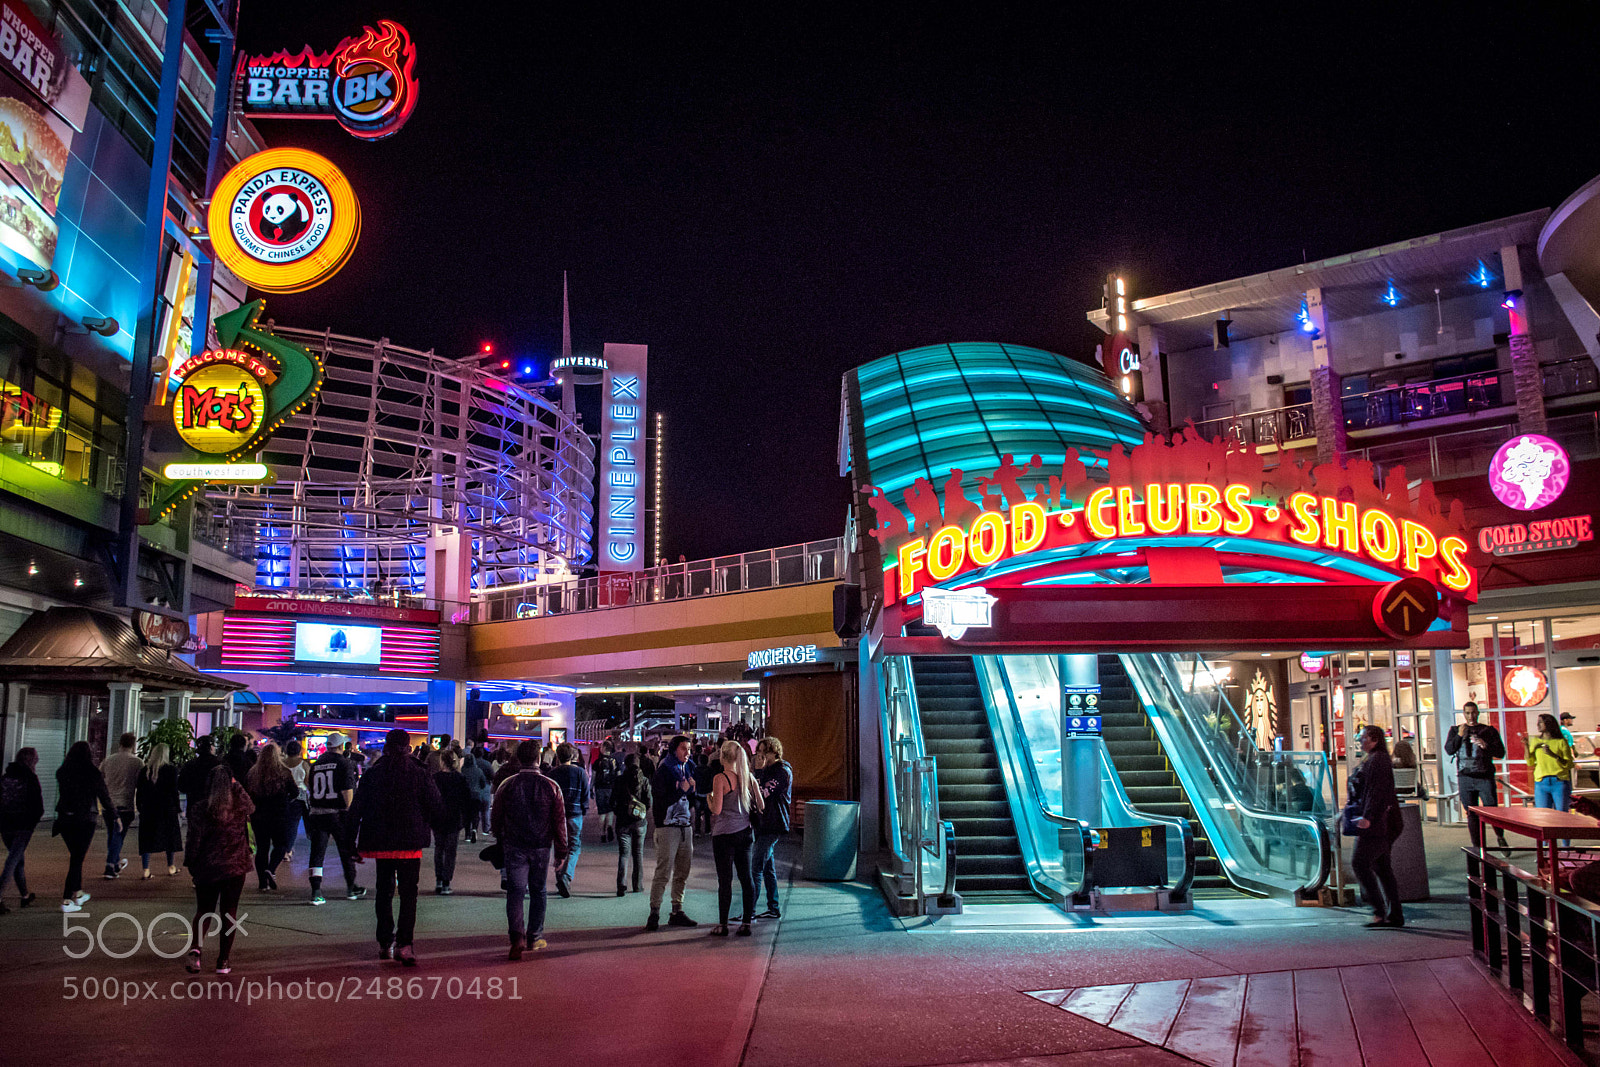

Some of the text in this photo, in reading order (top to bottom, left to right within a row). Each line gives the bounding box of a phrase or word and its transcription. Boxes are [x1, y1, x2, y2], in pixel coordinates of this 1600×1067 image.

[3, 3, 55, 67] WHOPPER
[0, 19, 51, 97] BAR
[248, 67, 330, 79] WHOPPER
[247, 78, 329, 105] BAR
[344, 70, 393, 107] BK
[234, 171, 328, 215] PANDA EXPRESS
[235, 222, 325, 258] GOURMET CHINESE FOOD
[174, 349, 267, 378] WELCOME TO
[554, 356, 609, 370] UNIVERSAL
[609, 376, 639, 562] CINEPLEX
[897, 483, 1472, 598] FOOD CLUBS SHOPS
[1479, 514, 1594, 553] COLD STONE
[1498, 539, 1572, 553] CREAMERY
[266, 601, 298, 611] amc
[300, 602, 351, 615] UNIVERSAL
[747, 644, 817, 669] CONCIERGE
[313, 770, 338, 799] 01
